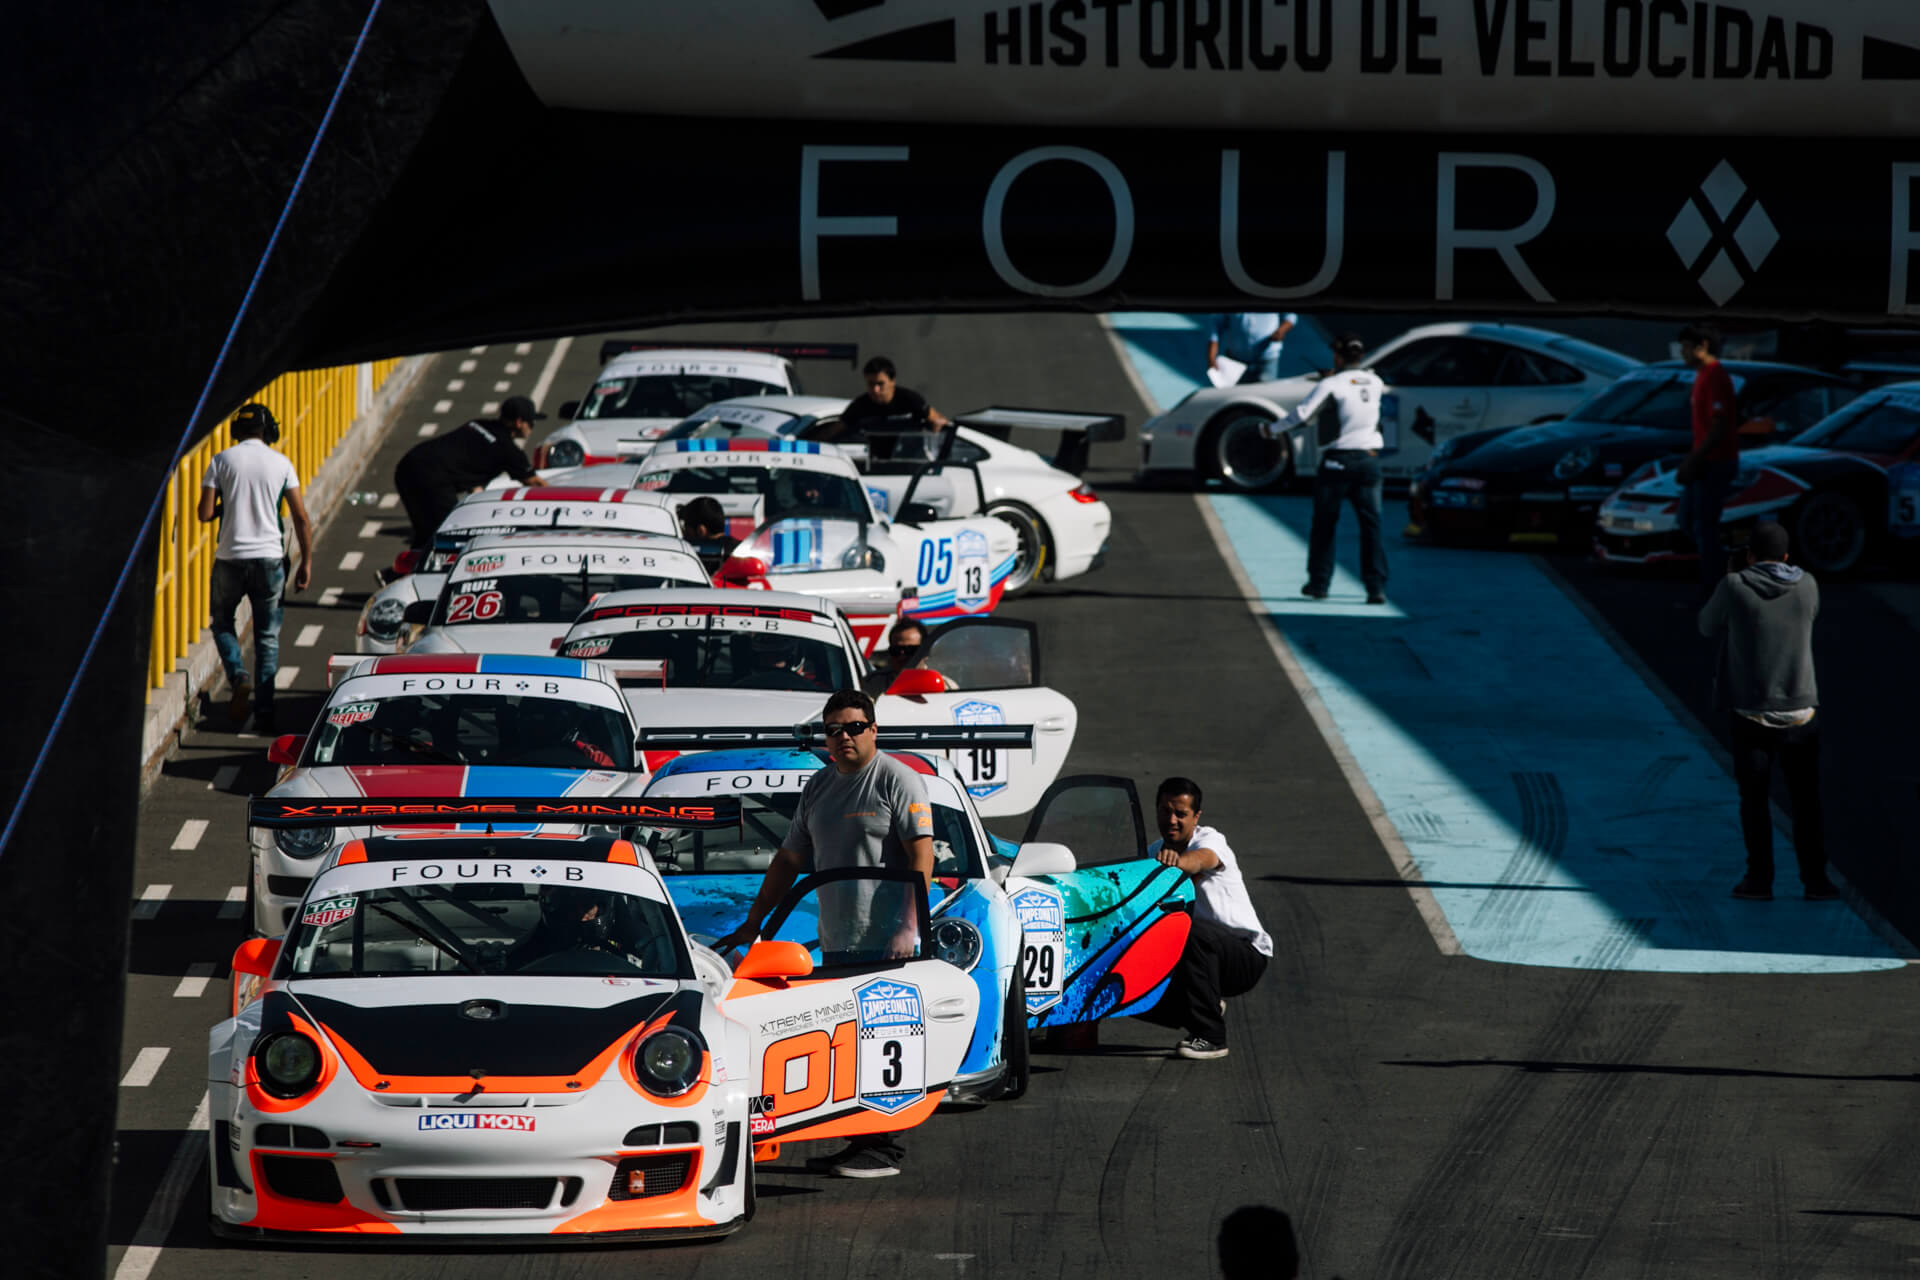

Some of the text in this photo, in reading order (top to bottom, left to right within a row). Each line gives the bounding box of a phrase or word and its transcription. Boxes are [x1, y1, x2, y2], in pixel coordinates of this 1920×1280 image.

[983, 0, 1834, 80] HISTORICO DE VELOCIDAD
[800, 144, 1558, 303] FOUR
[687, 455, 760, 465] FOUR
[491, 506, 617, 520] FOUR B
[521, 554, 656, 568] FOUR B
[917, 537, 953, 587] 05
[461, 579, 497, 595] RUIZ
[964, 566, 981, 594] 13
[447, 591, 502, 624] 26
[593, 605, 814, 622] PORSCHE
[635, 617, 779, 631] FOUR B
[402, 678, 559, 694] FOUR B
[337, 704, 371, 714] TAG
[967, 747, 996, 781] 19
[281, 804, 715, 820] XTREME MINING
[392, 863, 584, 882] FOUR B
[311, 899, 353, 913] TAG
[304, 909, 353, 926] HEUER
[1024, 944, 1054, 988] 29
[760, 1010, 812, 1034] XTREME
[815, 999, 856, 1019] MINING
[862, 998, 920, 1021] CAMPEONATO
[762, 1018, 857, 1119] 01
[882, 1040, 903, 1088] 3
[420, 1115, 535, 1130] LIQUI MOLY
